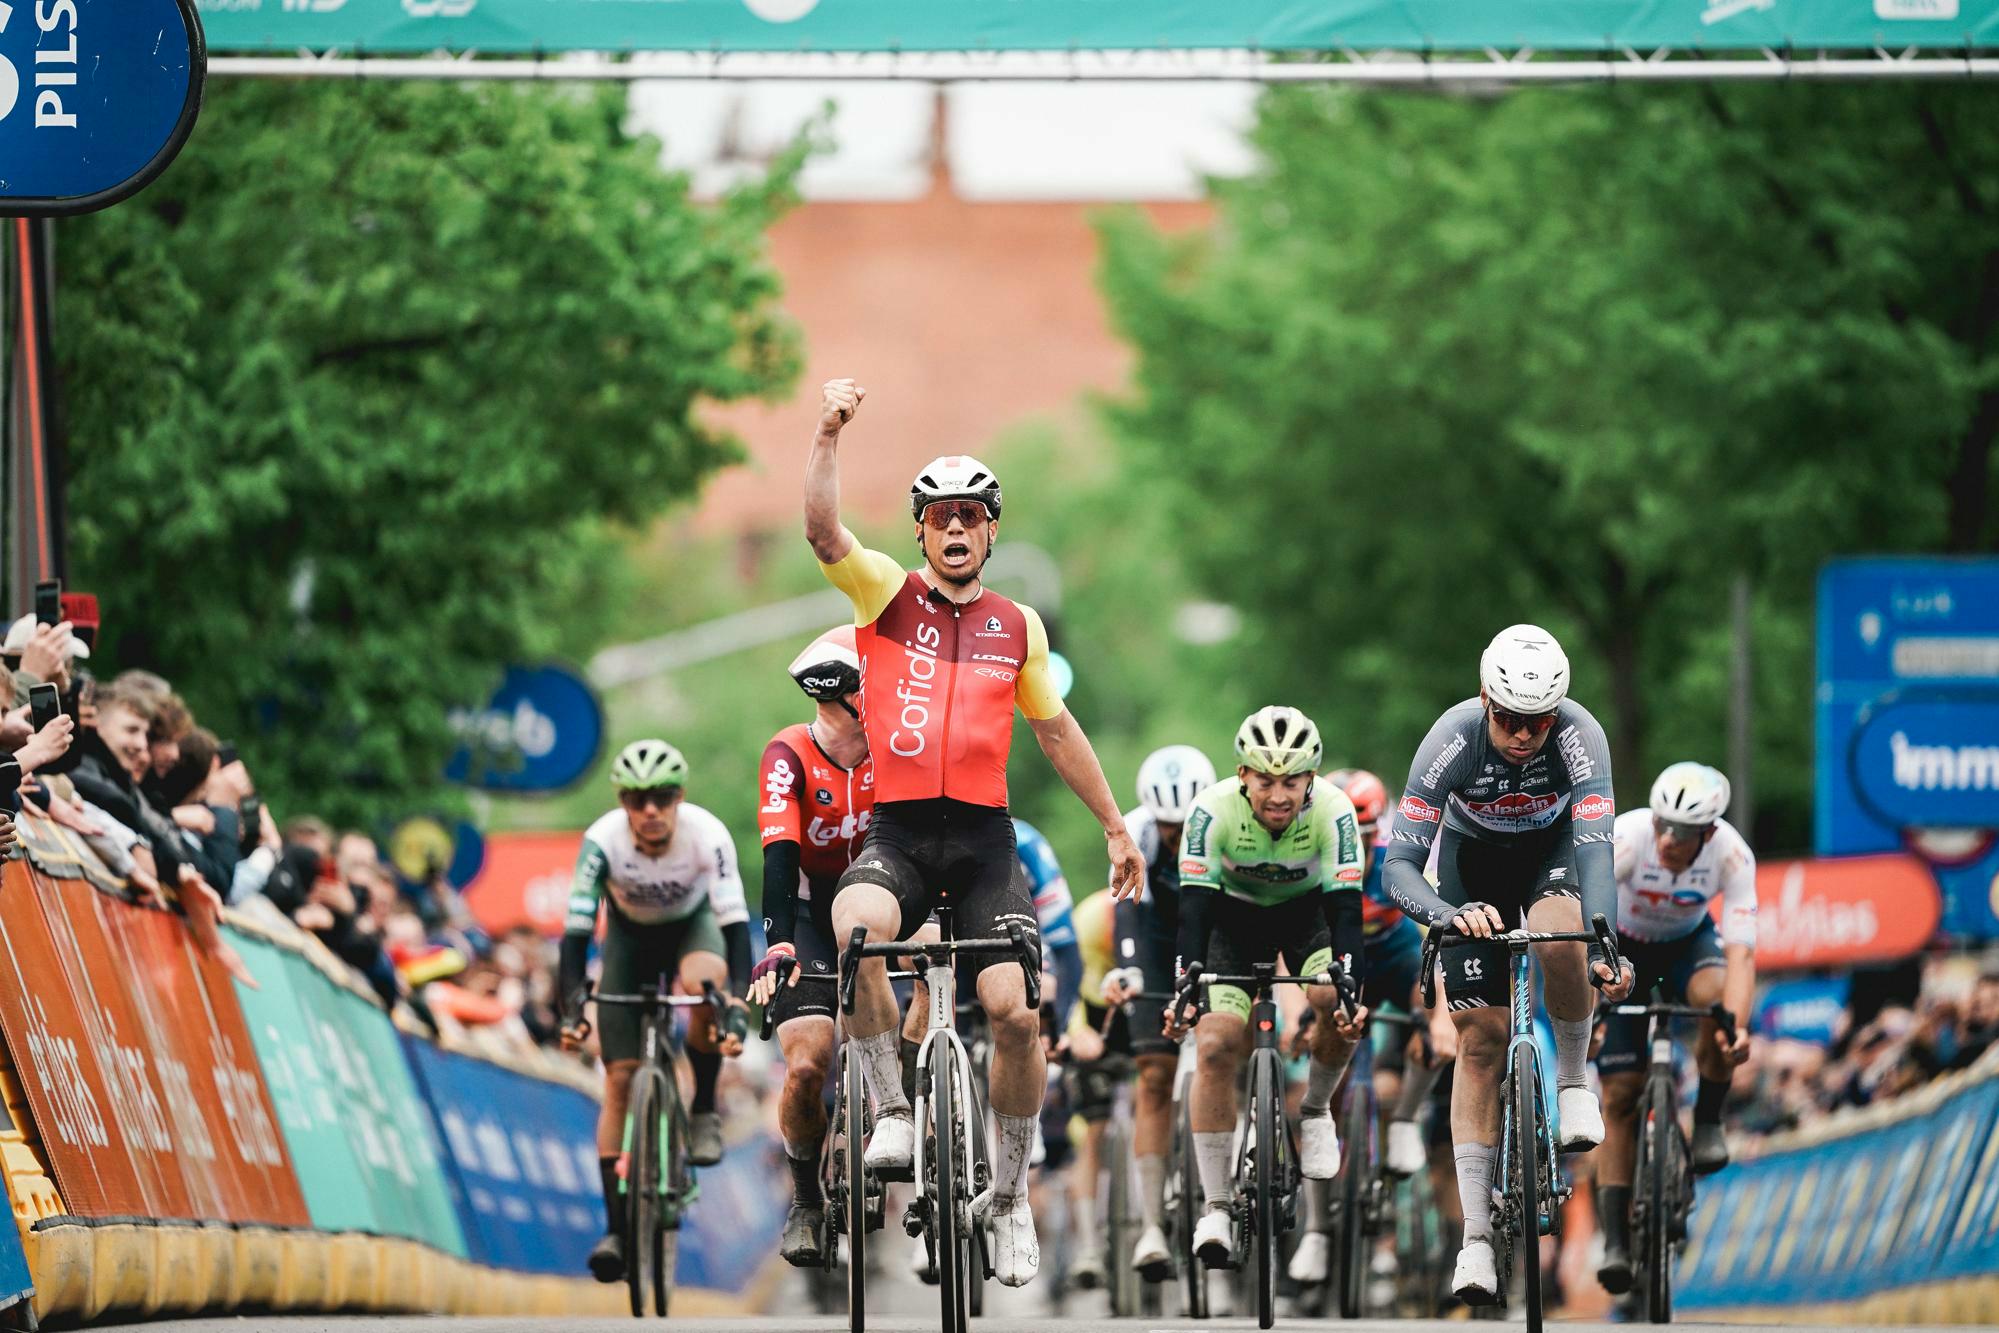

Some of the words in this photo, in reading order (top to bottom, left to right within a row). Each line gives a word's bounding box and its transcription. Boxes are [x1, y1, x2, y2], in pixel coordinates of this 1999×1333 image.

[971, 653, 1020, 667] LOOK
[889, 622, 940, 757] Cofidis
[1420, 732, 1468, 790] deceuninck
[1558, 724, 1596, 784] Alpecin
[1401, 799, 1437, 818] Alpecin
[1480, 798, 1550, 815] Alpecin
[1575, 800, 1611, 816] Alpecin
[1390, 883, 1423, 915] WHOOP
